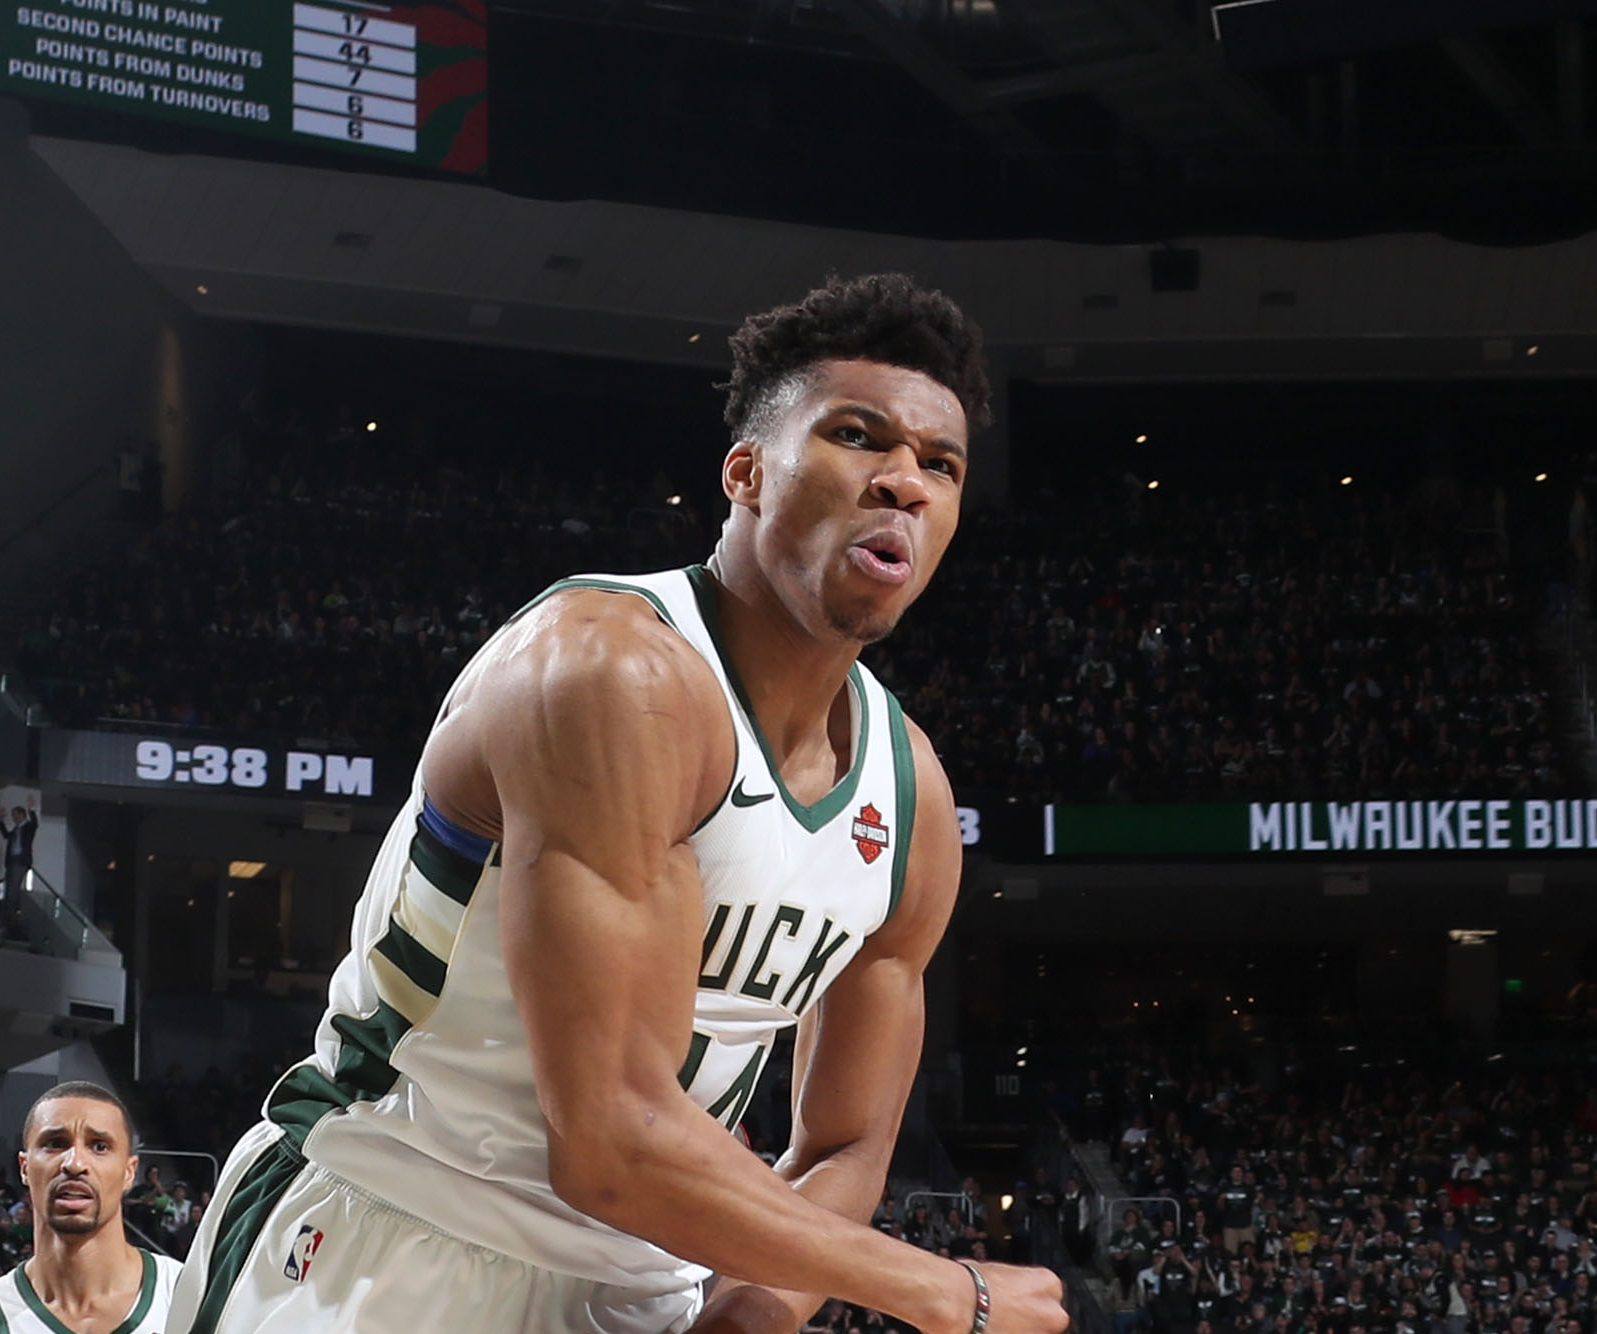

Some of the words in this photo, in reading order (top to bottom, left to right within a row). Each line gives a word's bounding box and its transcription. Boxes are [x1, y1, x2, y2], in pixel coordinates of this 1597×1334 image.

[16, 7, 101, 38] SECOND
[104, 24, 187, 54] CHANCE
[190, 40, 263, 69] POINTS
[138, 3, 159, 21] IN
[164, 7, 223, 33] PAINT
[342, 14, 368, 35] 17
[35, 38, 109, 67] POINTS
[113, 53, 171, 79] FROM
[176, 64, 245, 92] DUNKS
[338, 42, 372, 64] 44
[8, 59, 83, 88] POINTS
[87, 73, 145, 99] FROM
[150, 85, 271, 122] TURNOVERS
[347, 65, 363, 87] 7
[347, 95, 363, 115] 6
[347, 119, 363, 140] 6
[136, 741, 267, 788] 9:38
[285, 752, 373, 796] PM
[1250, 801, 1512, 851] MILWAUKEE
[698, 902, 851, 1019] UCK
